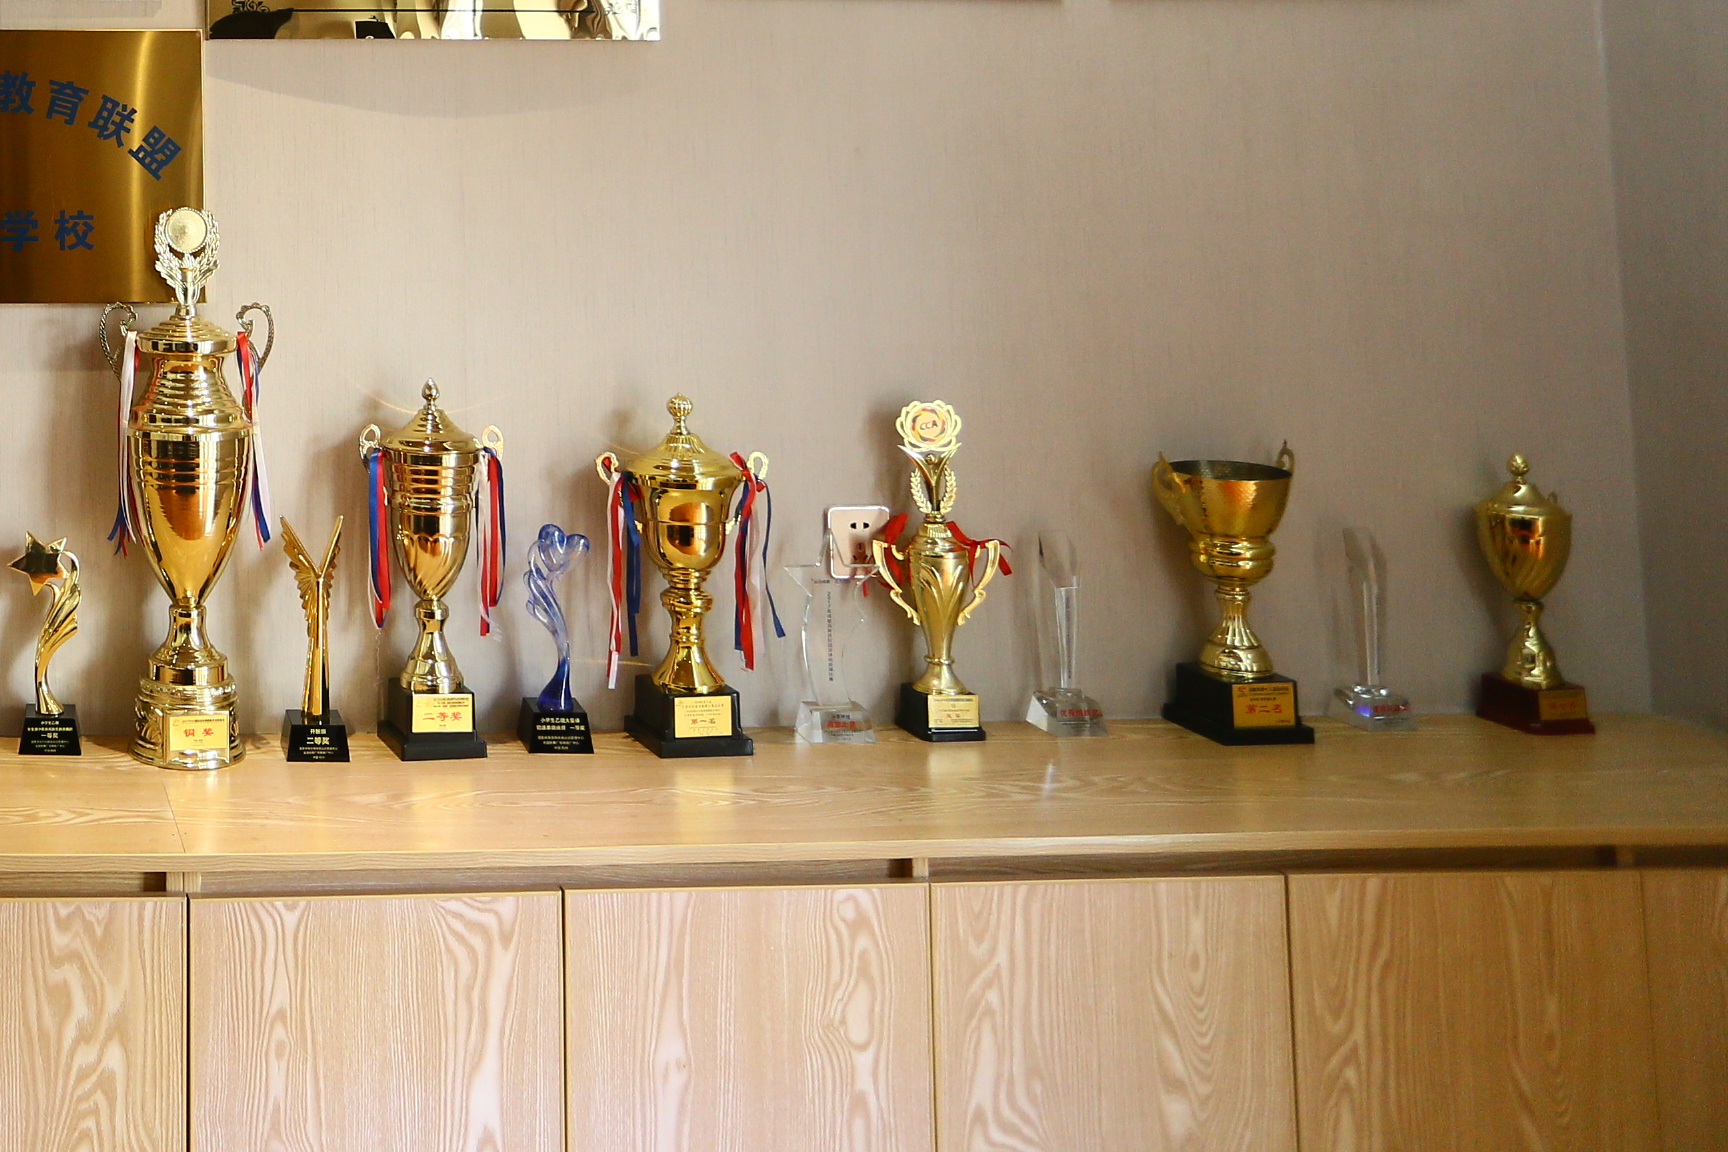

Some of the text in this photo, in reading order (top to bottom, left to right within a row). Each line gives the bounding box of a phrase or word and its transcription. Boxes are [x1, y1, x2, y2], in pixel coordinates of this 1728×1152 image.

[919, 419, 939, 431] CCA
[422, 711, 463, 722] 二等奖
[690, 717, 716, 726] 第一名
[306, 736, 330, 745] 二等奖
